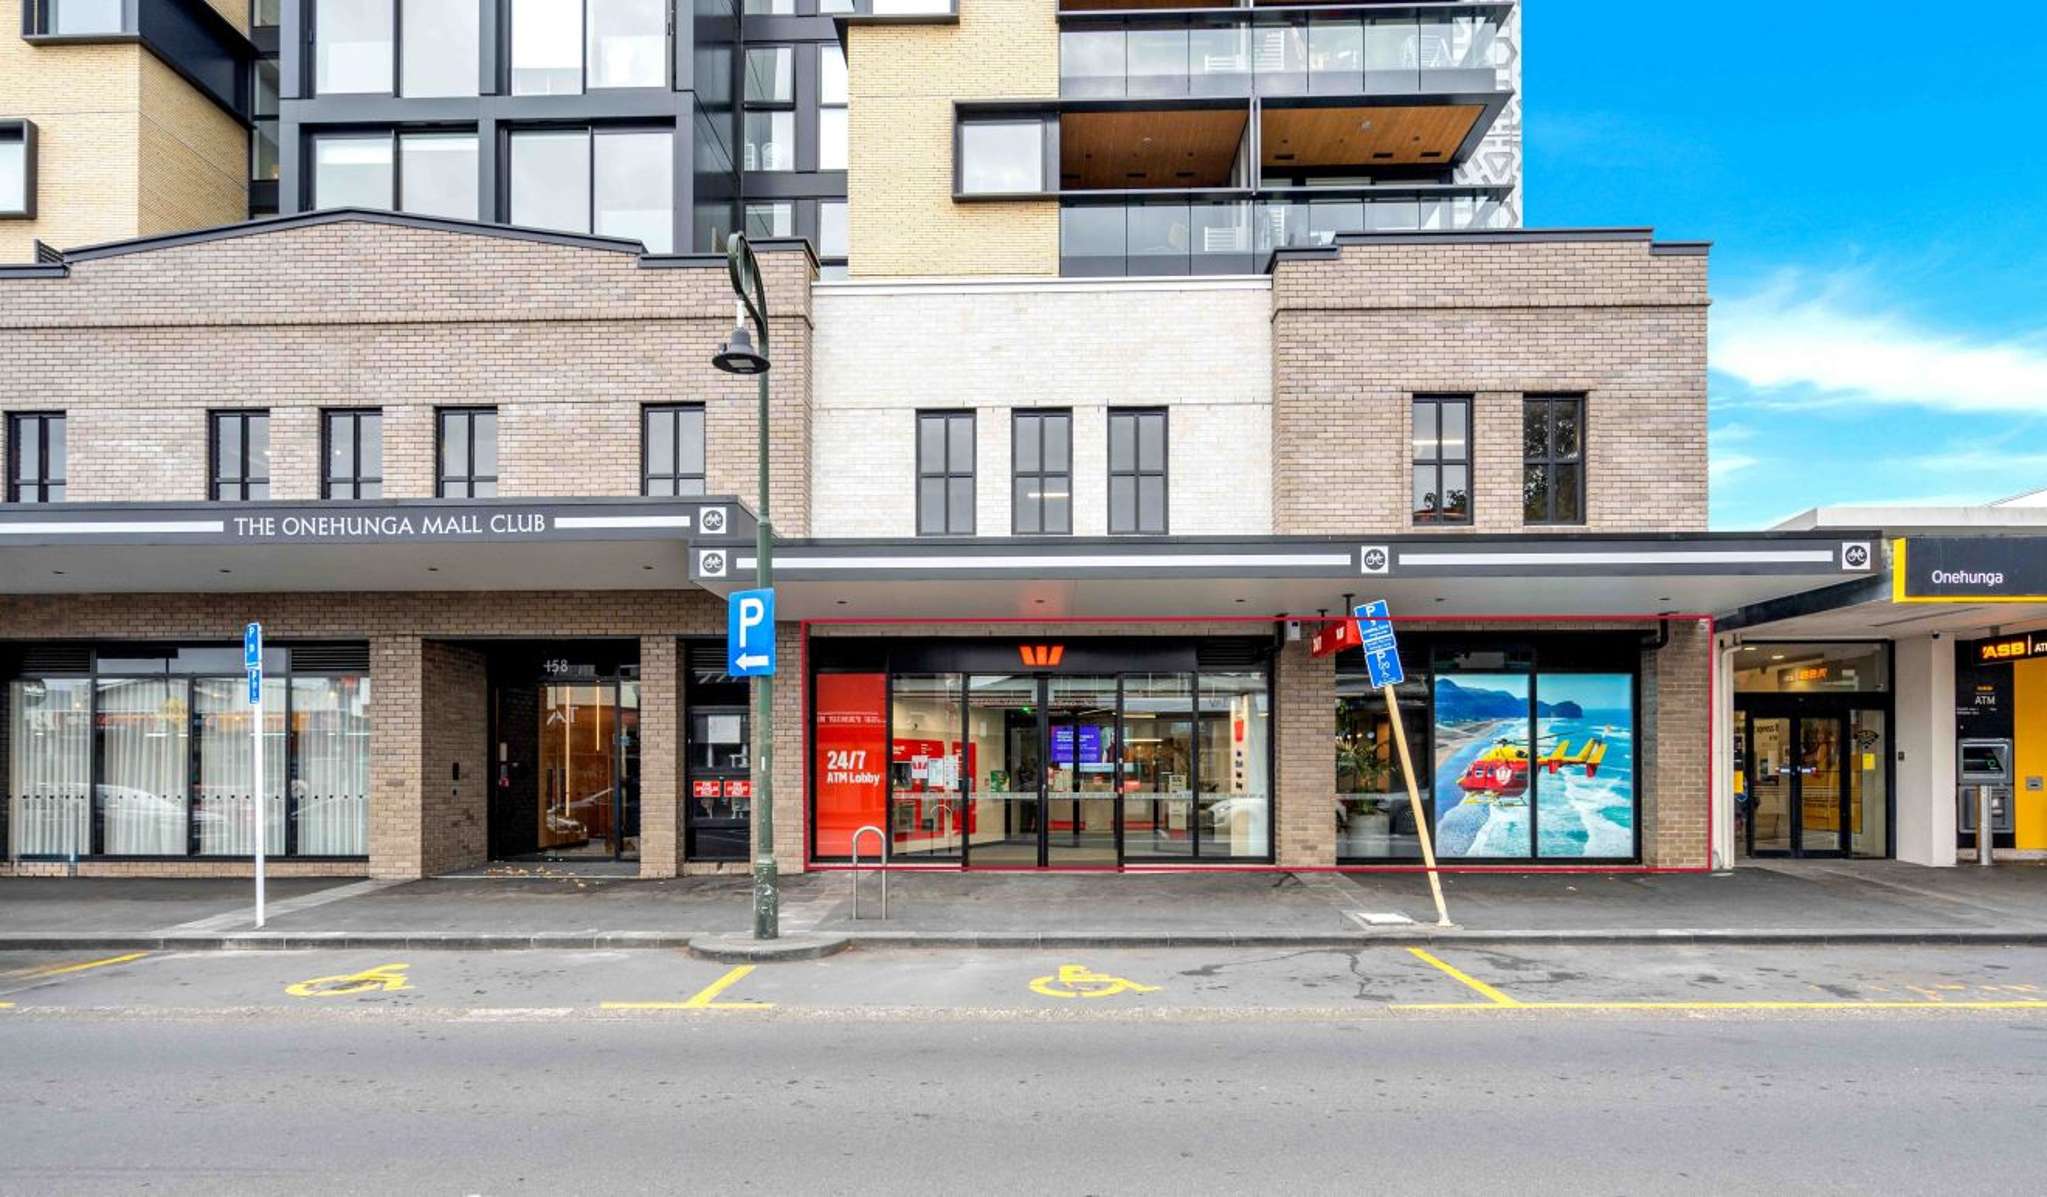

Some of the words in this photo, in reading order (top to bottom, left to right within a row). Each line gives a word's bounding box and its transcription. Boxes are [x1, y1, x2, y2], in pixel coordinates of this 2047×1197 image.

[234, 516, 275, 536] THE
[282, 516, 414, 536] ONEHUNGA
[421, 515, 483, 534] MALL
[490, 514, 545, 533] CLUB
[1931, 570, 2004, 587] Onehunga
[739, 598, 765, 648] P
[2034, 642, 2047, 653] AT
[1974, 695, 1996, 705] ATM
[827, 750, 866, 770] 24/7
[827, 771, 848, 785] ATM
[849, 771, 880, 788] Lobby
